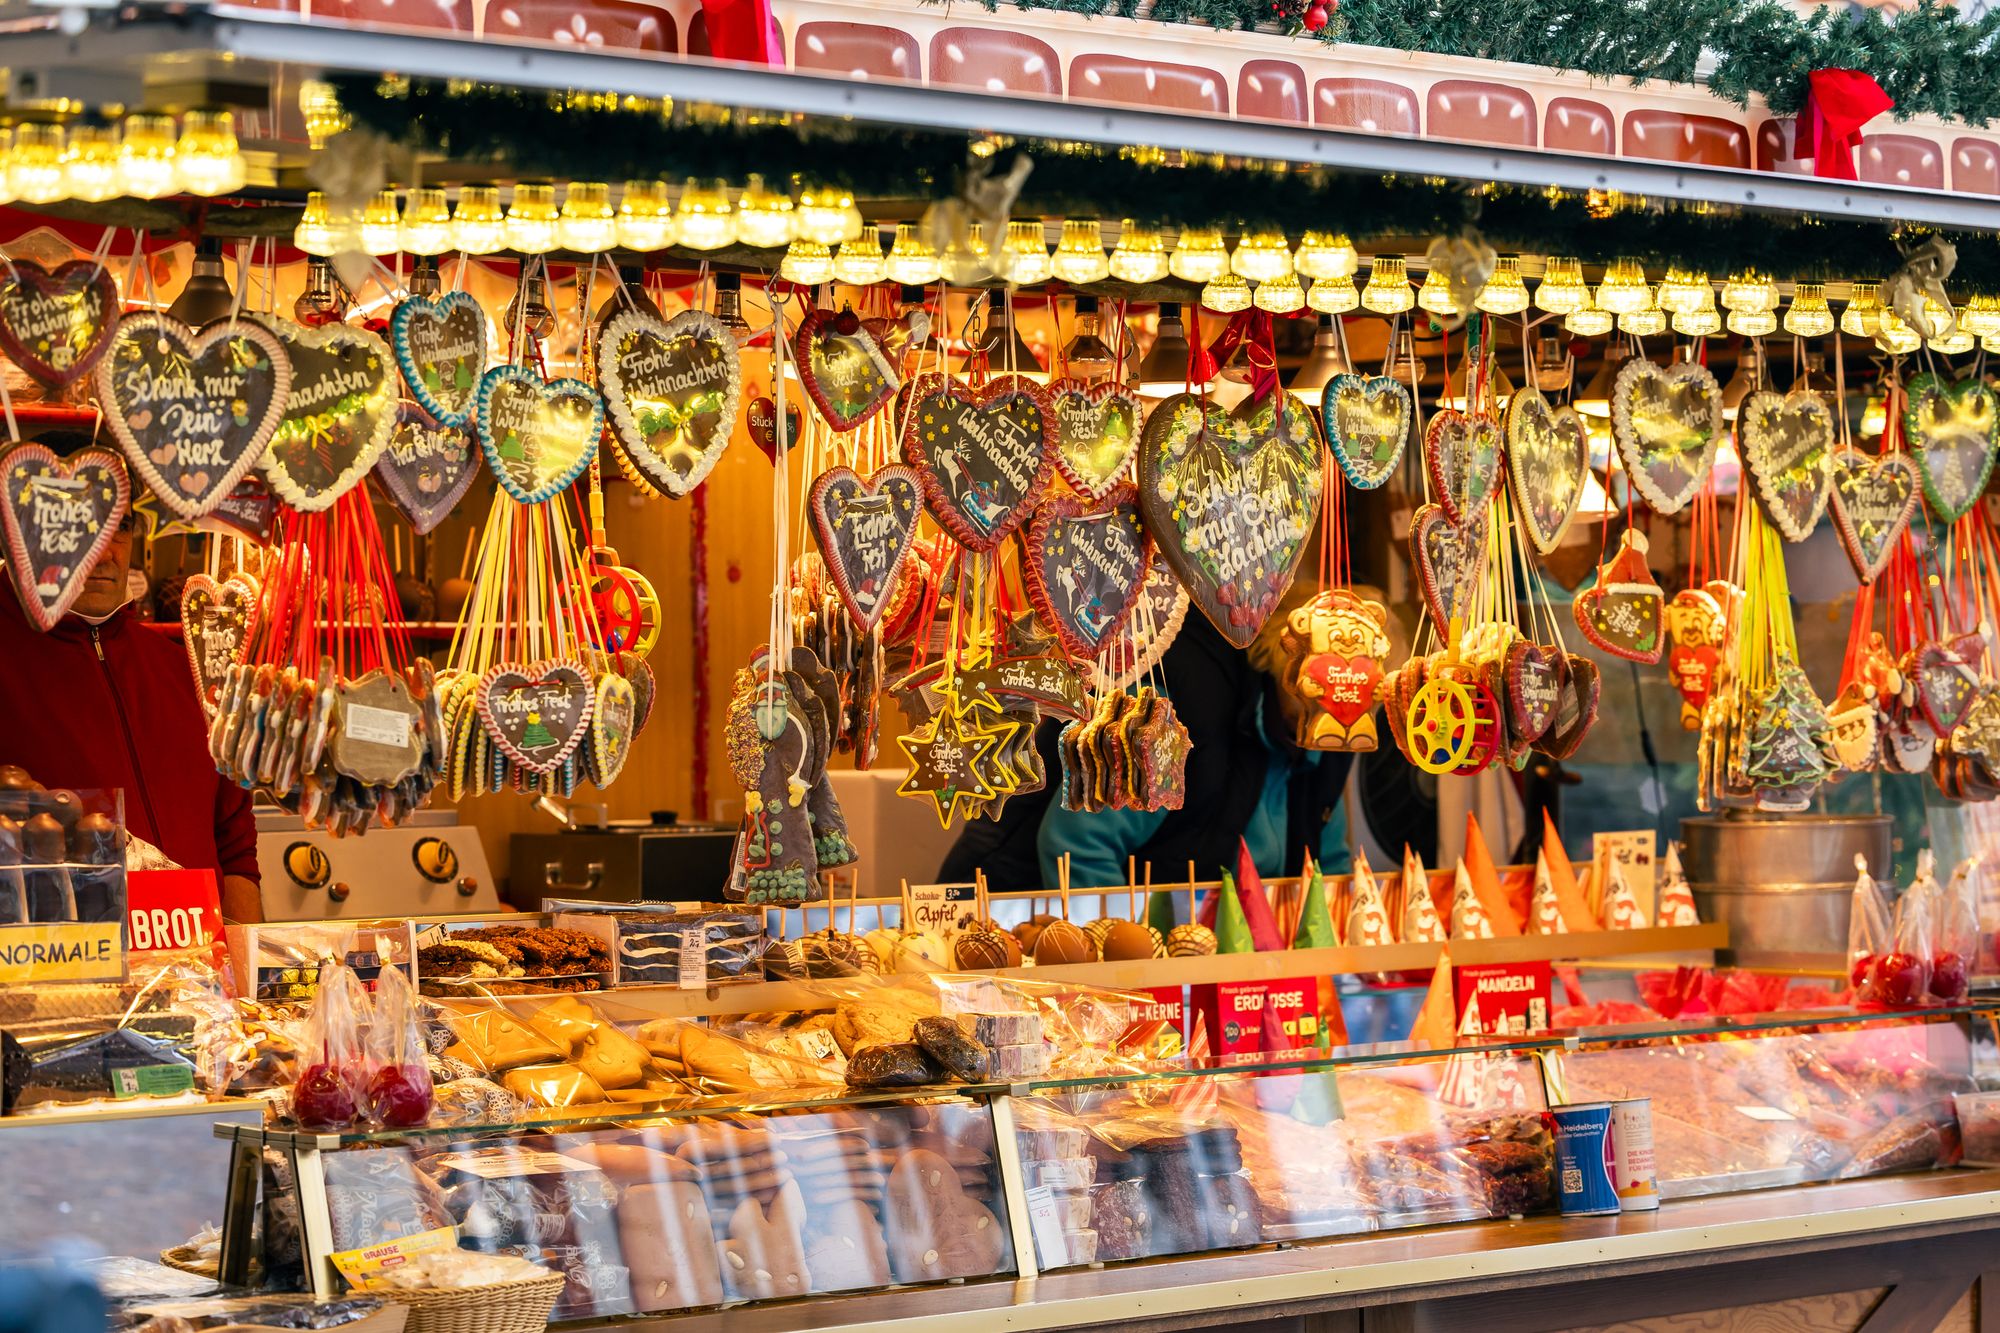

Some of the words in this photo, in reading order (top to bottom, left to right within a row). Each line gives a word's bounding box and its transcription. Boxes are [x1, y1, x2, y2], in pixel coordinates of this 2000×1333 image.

[621, 347, 674, 379] Frohe
[125, 363, 203, 406] Schenk
[204, 366, 245, 397] mir
[628, 360, 729, 401] Weihnachten
[501, 388, 542, 415] Frohe
[1061, 402, 1103, 422] Frohes
[751, 415, 774, 427] Stück
[1070, 421, 1098, 440] Fest
[175, 438, 231, 466] Herz
[956, 407, 1029, 494] Weihnachten
[997, 414, 1040, 475] Frohe
[33, 496, 94, 529] Frohes
[40, 522, 83, 554] Fest
[1199, 511, 1240, 551] mir
[1070, 525, 1129, 593] Weihnachten
[1105, 524, 1140, 570] Frohe
[1001, 666, 1036, 690] Frohes
[1038, 675, 1065, 696] Fest
[1327, 665, 1369, 685] Frohes
[490, 692, 540, 714] Frohes
[538, 687, 573, 710] Fest
[1332, 686, 1361, 704] Fest
[929, 743, 964, 761] Frohes
[933, 759, 958, 774] Fest
[914, 891, 942, 901] Schoko-
[129, 906, 205, 951] BROT
[914, 902, 959, 930] Äpfel
[0, 938, 112, 966] NORMALE
[1477, 975, 1536, 994] MANDELN
[1563, 1122, 1604, 1132] Heidelberg
[363, 1245, 399, 1260] BRAUSE
